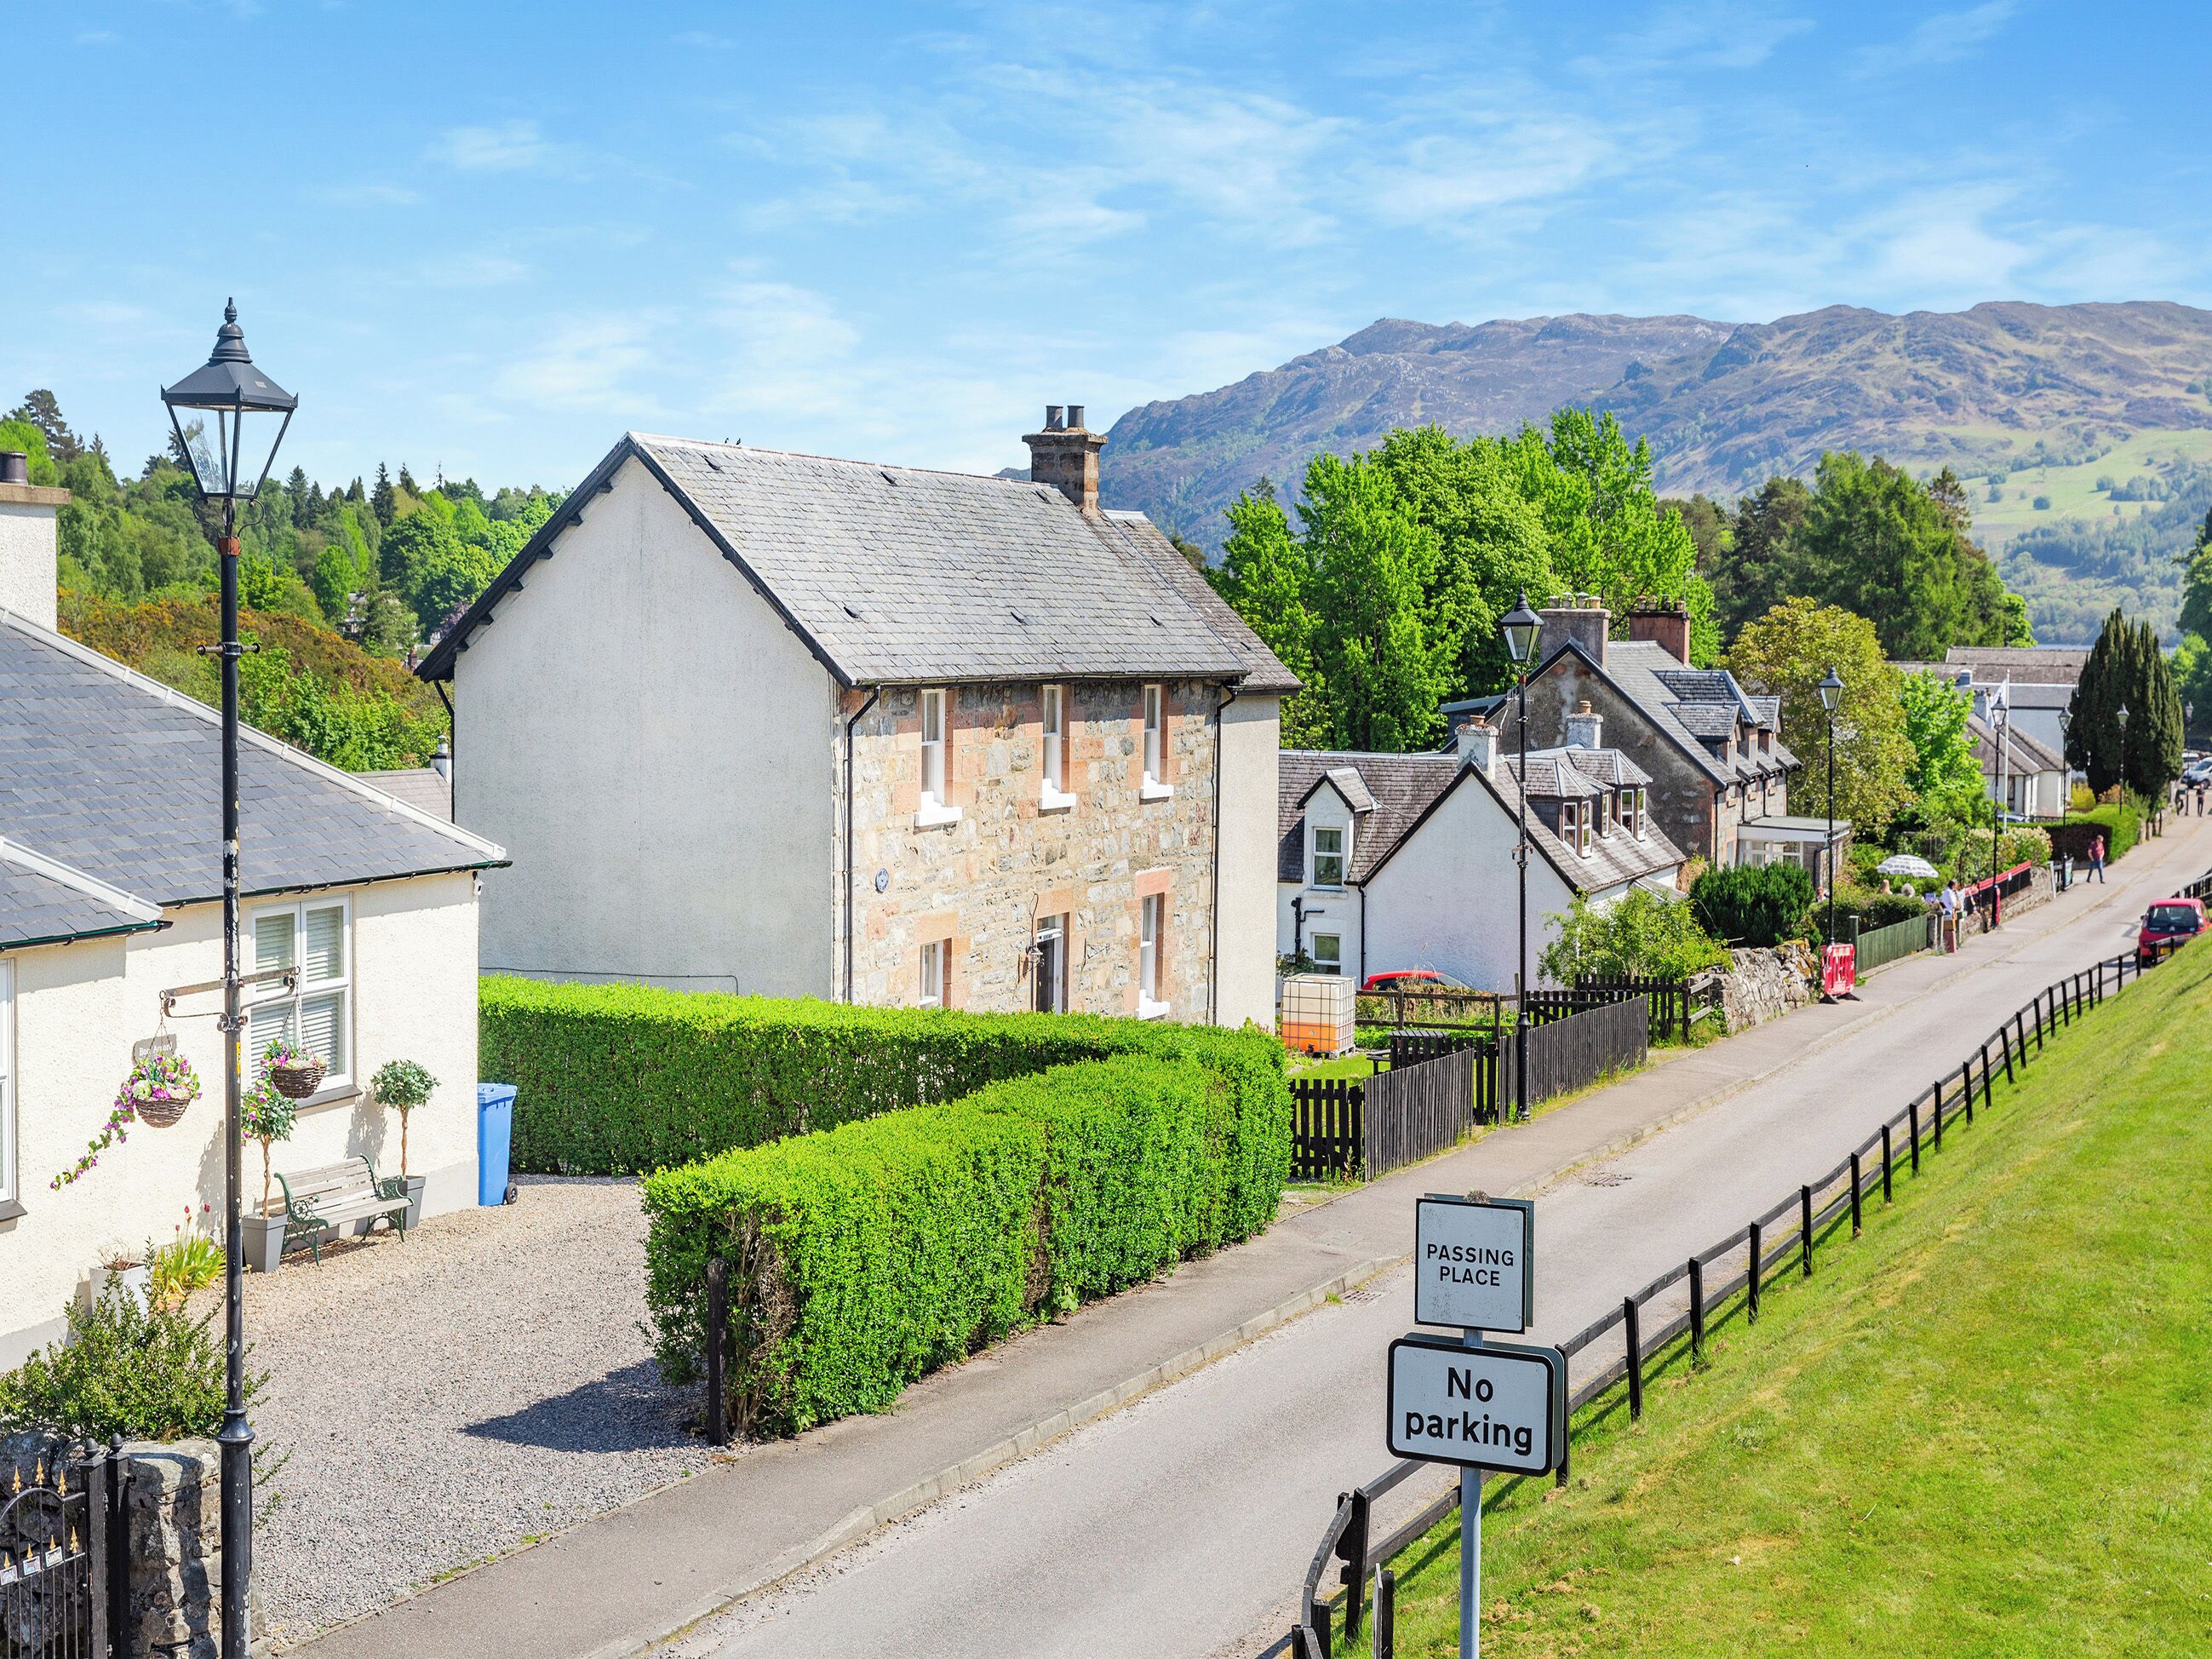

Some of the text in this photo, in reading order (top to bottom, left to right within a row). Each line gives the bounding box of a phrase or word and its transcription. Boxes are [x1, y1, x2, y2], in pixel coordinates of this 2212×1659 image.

[1427, 1243, 1514, 1266] PASSING
[1440, 1266, 1500, 1286] PLACE
[1447, 1367, 1493, 1403] No
[1406, 1410, 1532, 1456] parking
